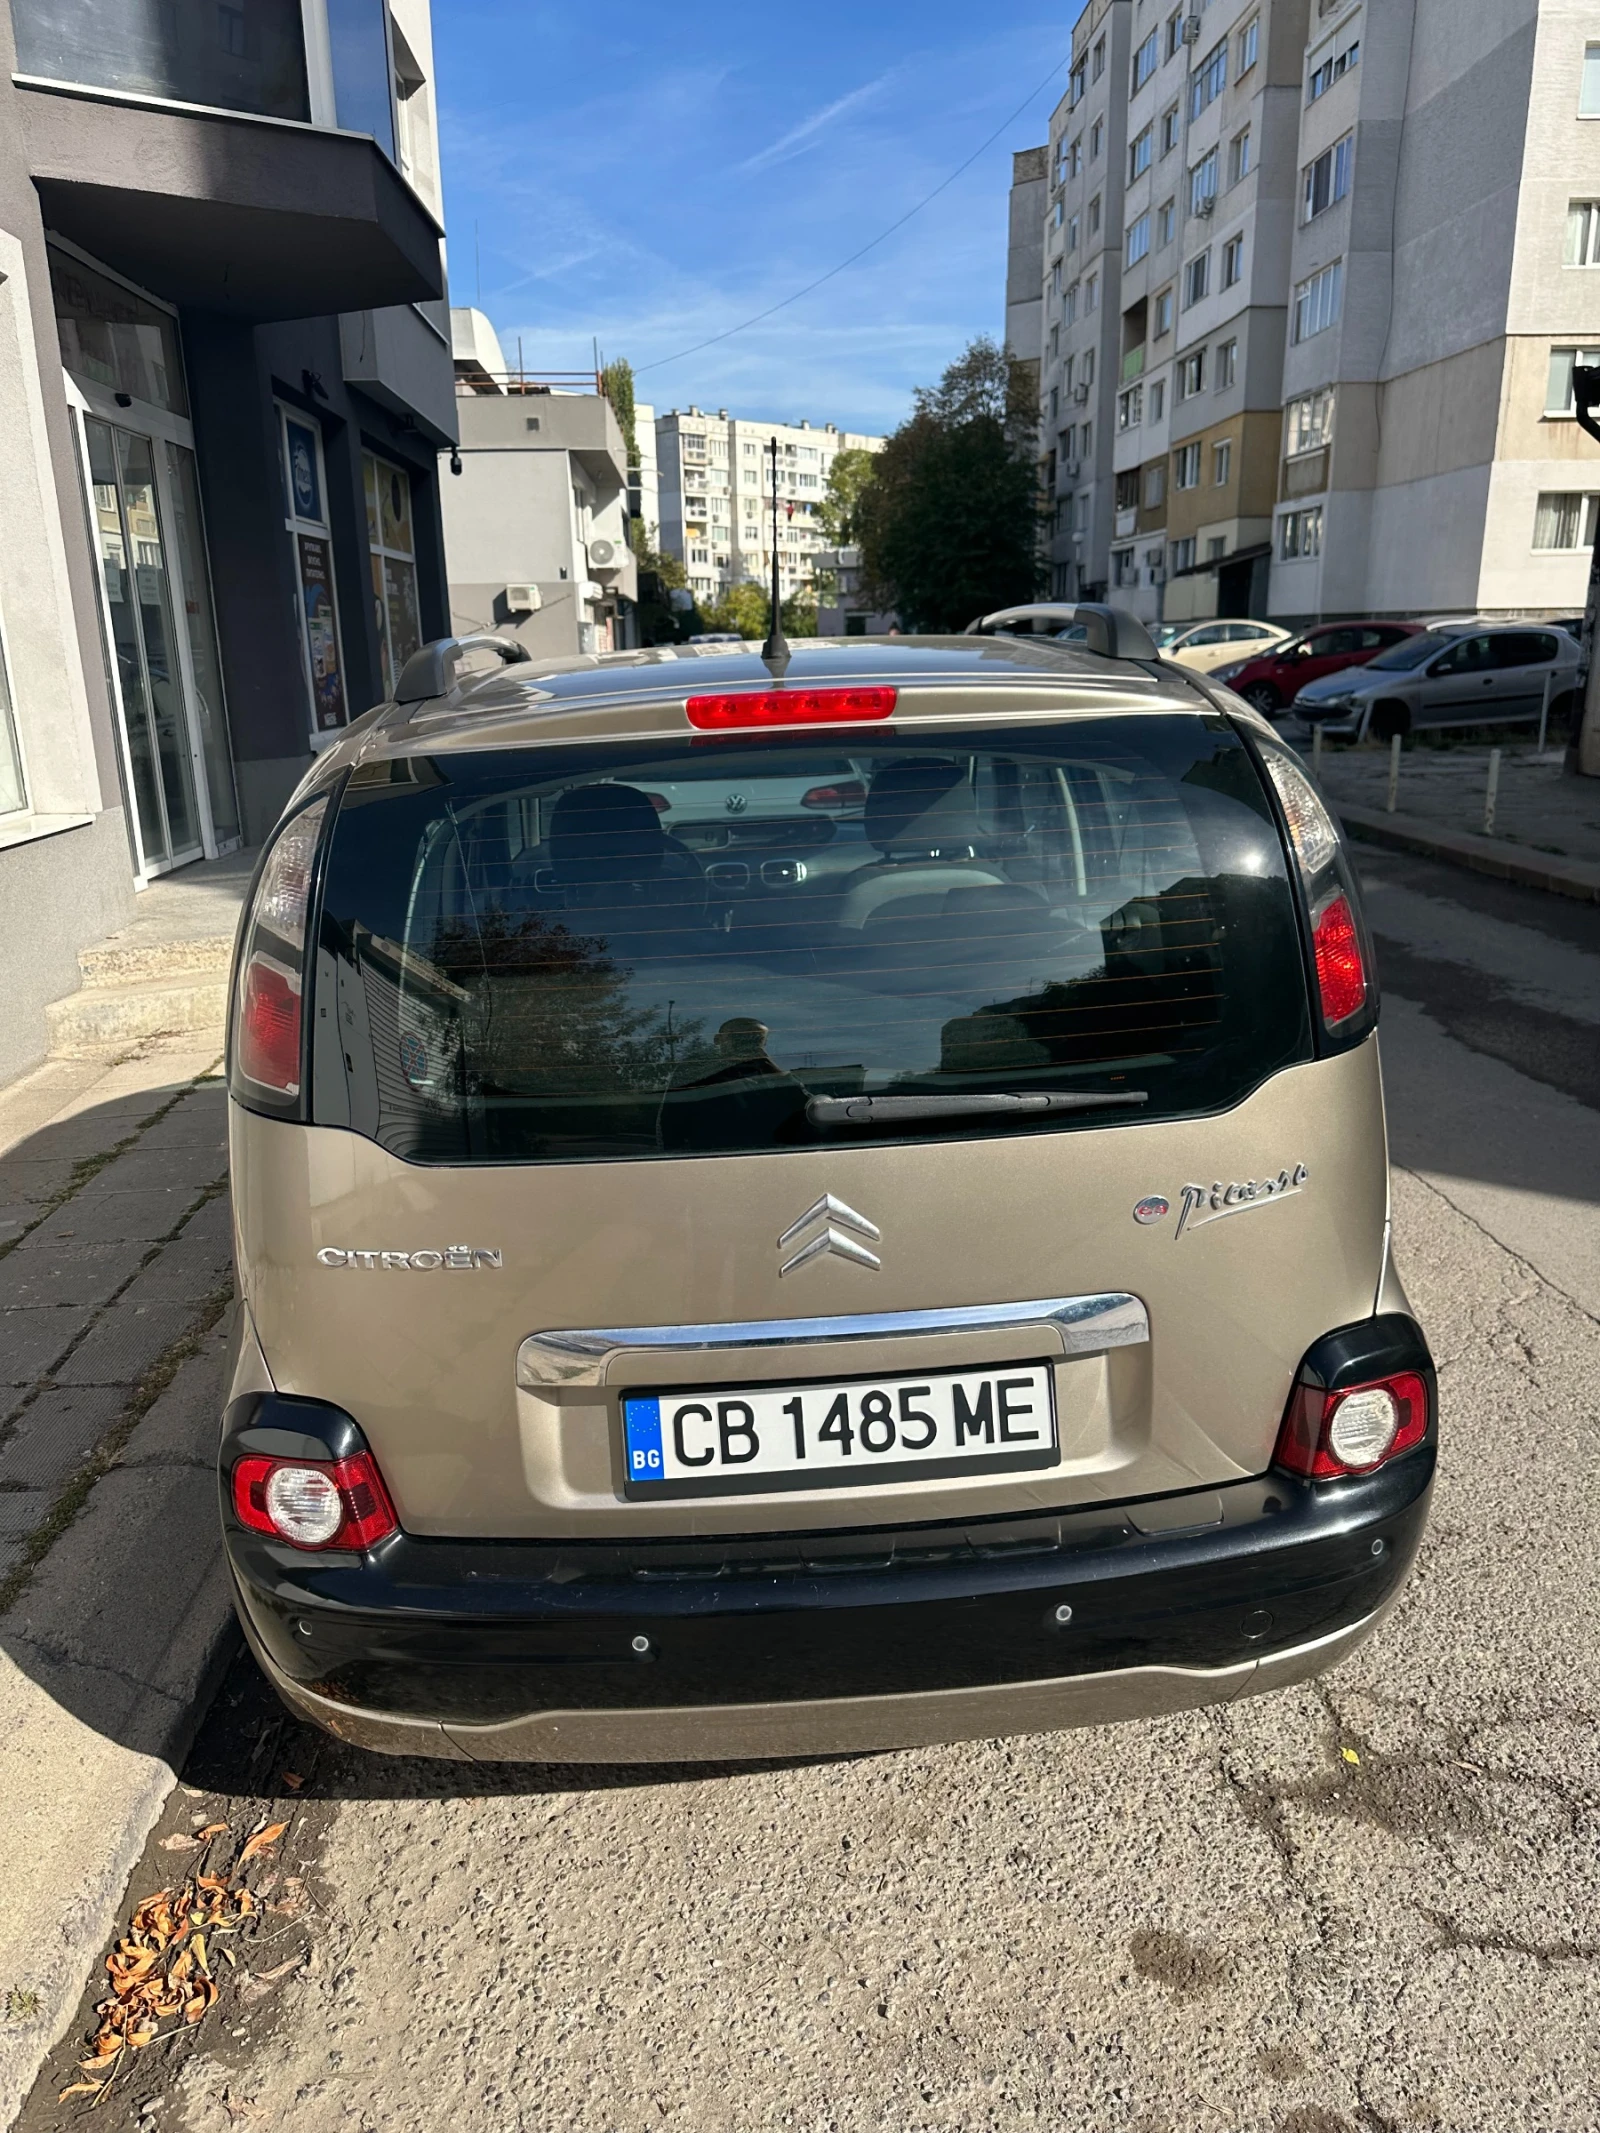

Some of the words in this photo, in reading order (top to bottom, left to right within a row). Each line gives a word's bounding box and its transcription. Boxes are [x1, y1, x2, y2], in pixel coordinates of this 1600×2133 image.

[1173, 1162, 1309, 1241] Picasso
[316, 1245, 502, 1270] CITROËN
[673, 1400, 760, 1467] CB
[783, 1386, 938, 1460] 1485
[952, 1377, 1040, 1447] ME
[633, 1450, 660, 1470] BG
